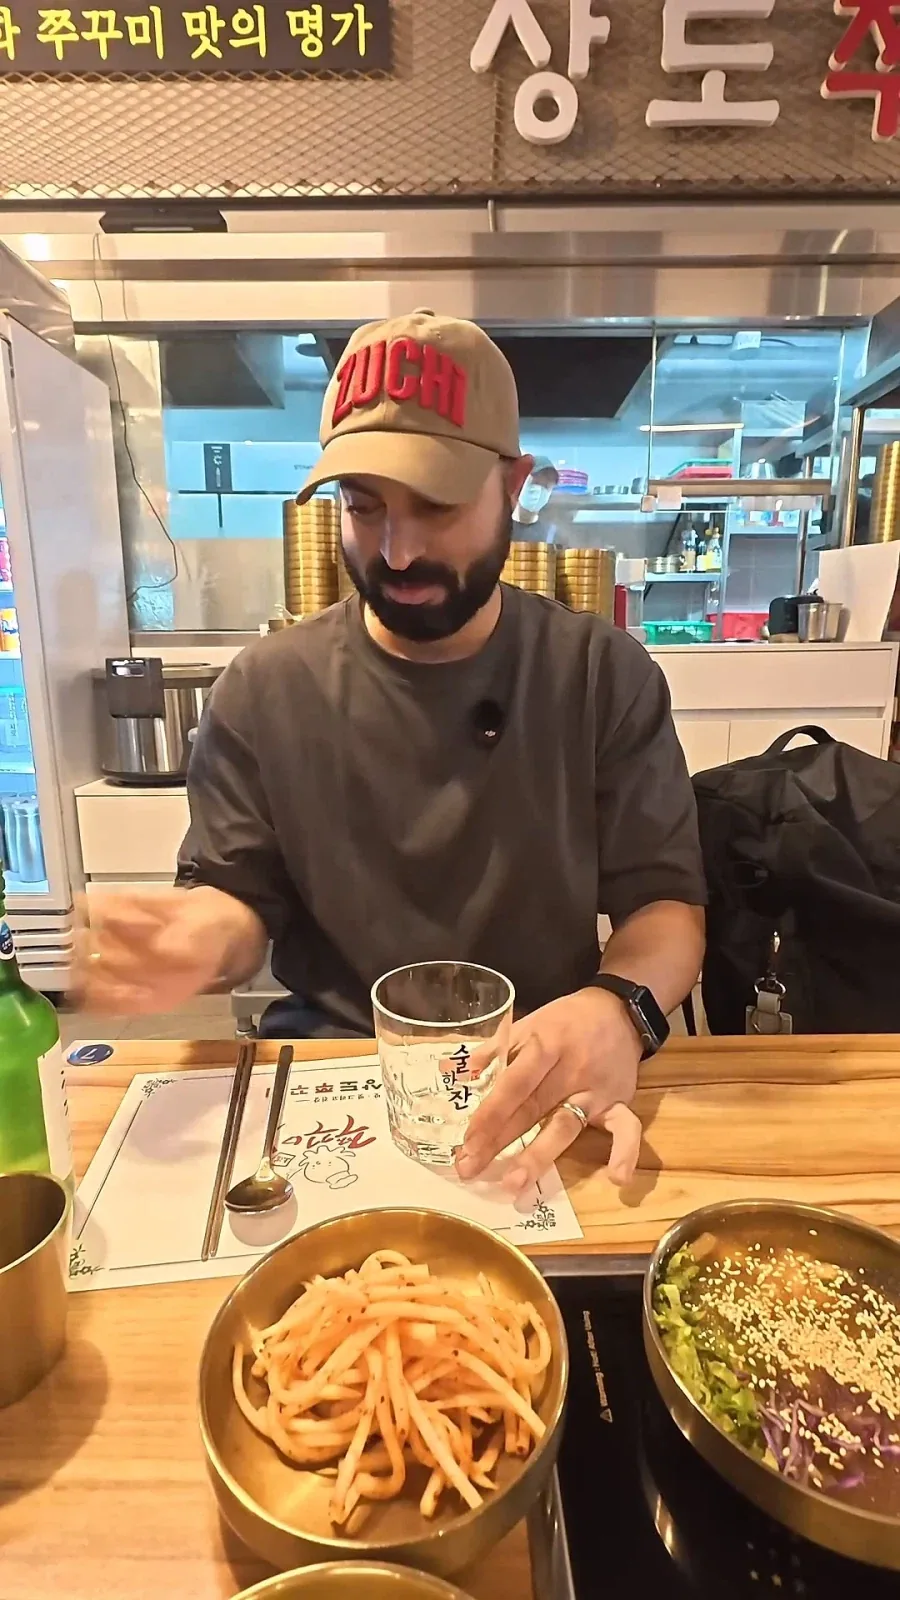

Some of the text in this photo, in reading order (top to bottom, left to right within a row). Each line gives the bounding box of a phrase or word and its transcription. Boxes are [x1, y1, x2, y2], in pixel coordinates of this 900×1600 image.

[37, 6, 165, 61] 쭈꾸미
[182, 4, 267, 60] 맛의
[286, 3, 374, 58] 명가
[332, 337, 468, 429] ZUCHI
[265, 1079, 382, 1098] 상도쭈꾸
